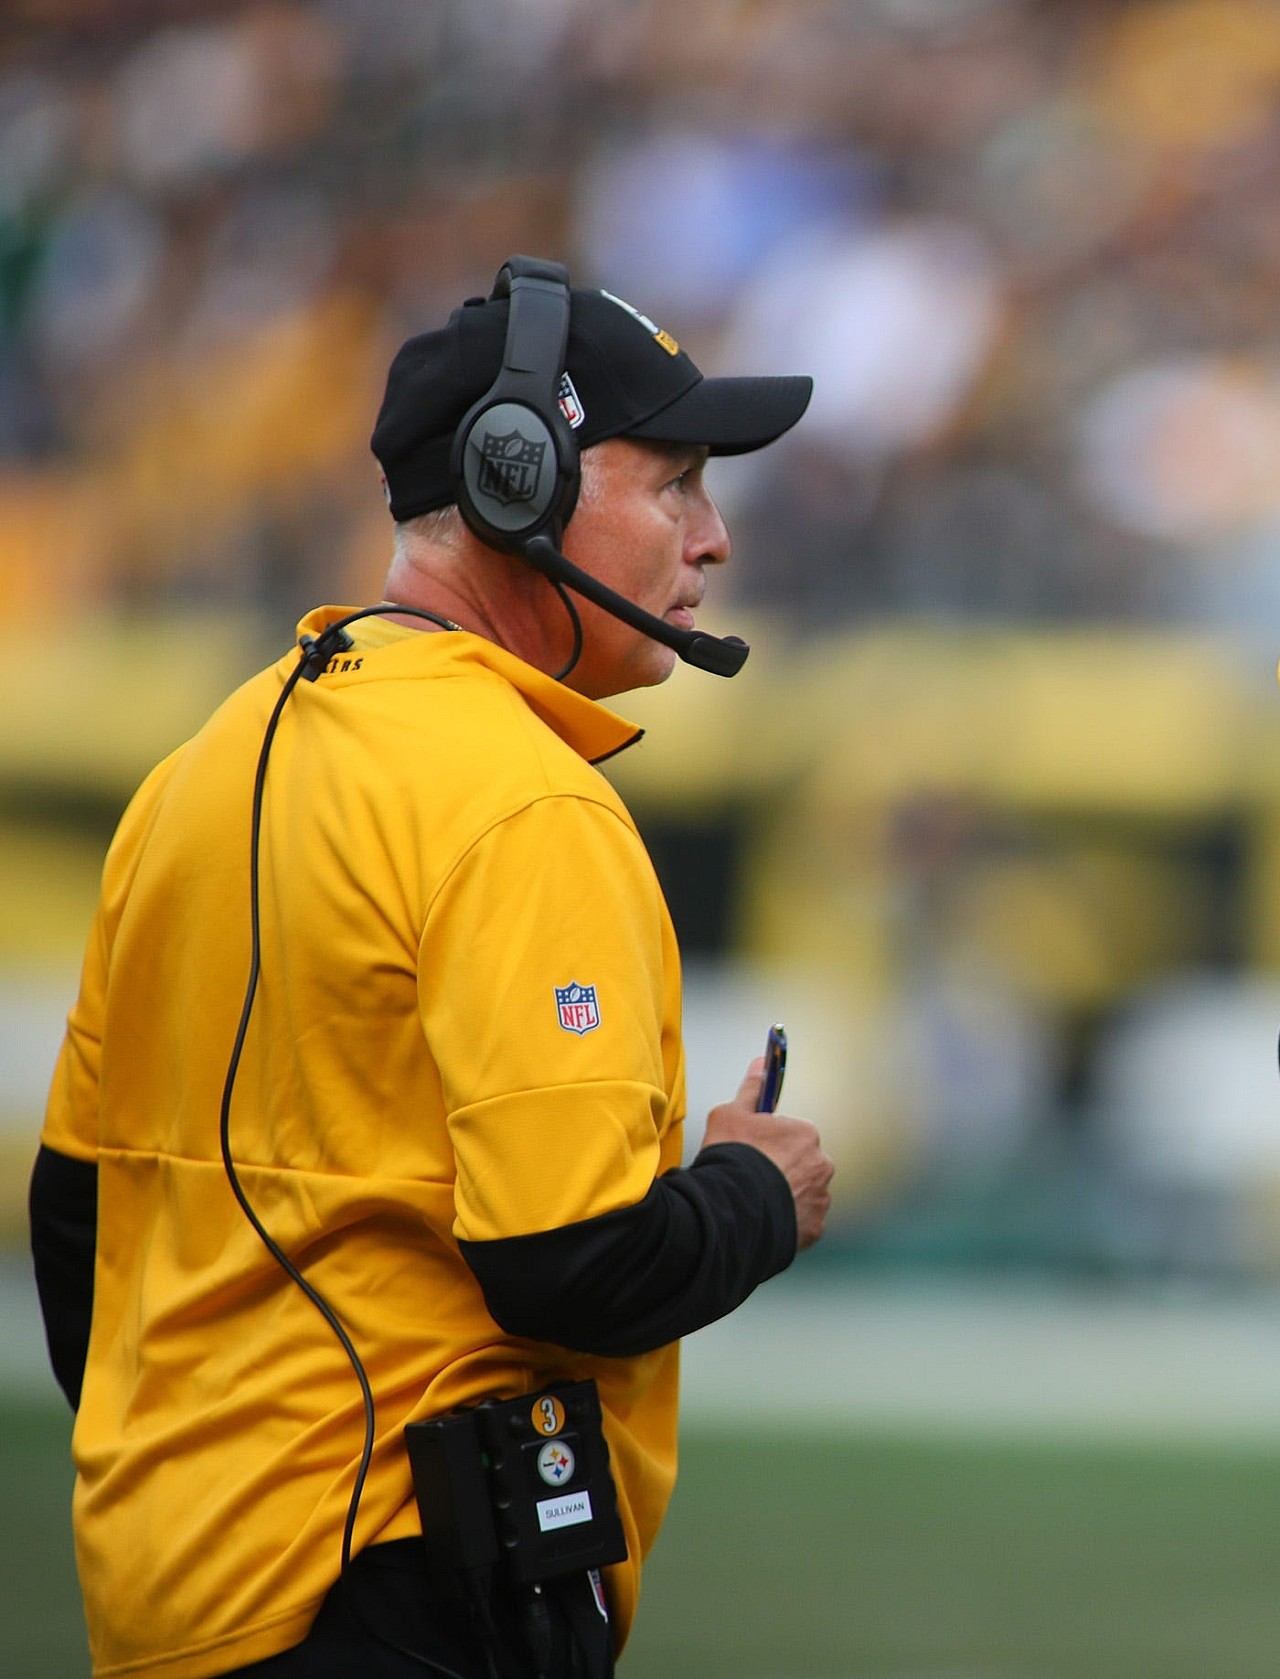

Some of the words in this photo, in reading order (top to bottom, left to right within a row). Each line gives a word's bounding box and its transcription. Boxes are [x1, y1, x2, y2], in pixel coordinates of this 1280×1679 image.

[483, 457, 532, 497] NFL
[561, 1004, 596, 1029] NFL
[541, 1398, 557, 1433] 3
[545, 1501, 585, 1519] SULLIVAN
